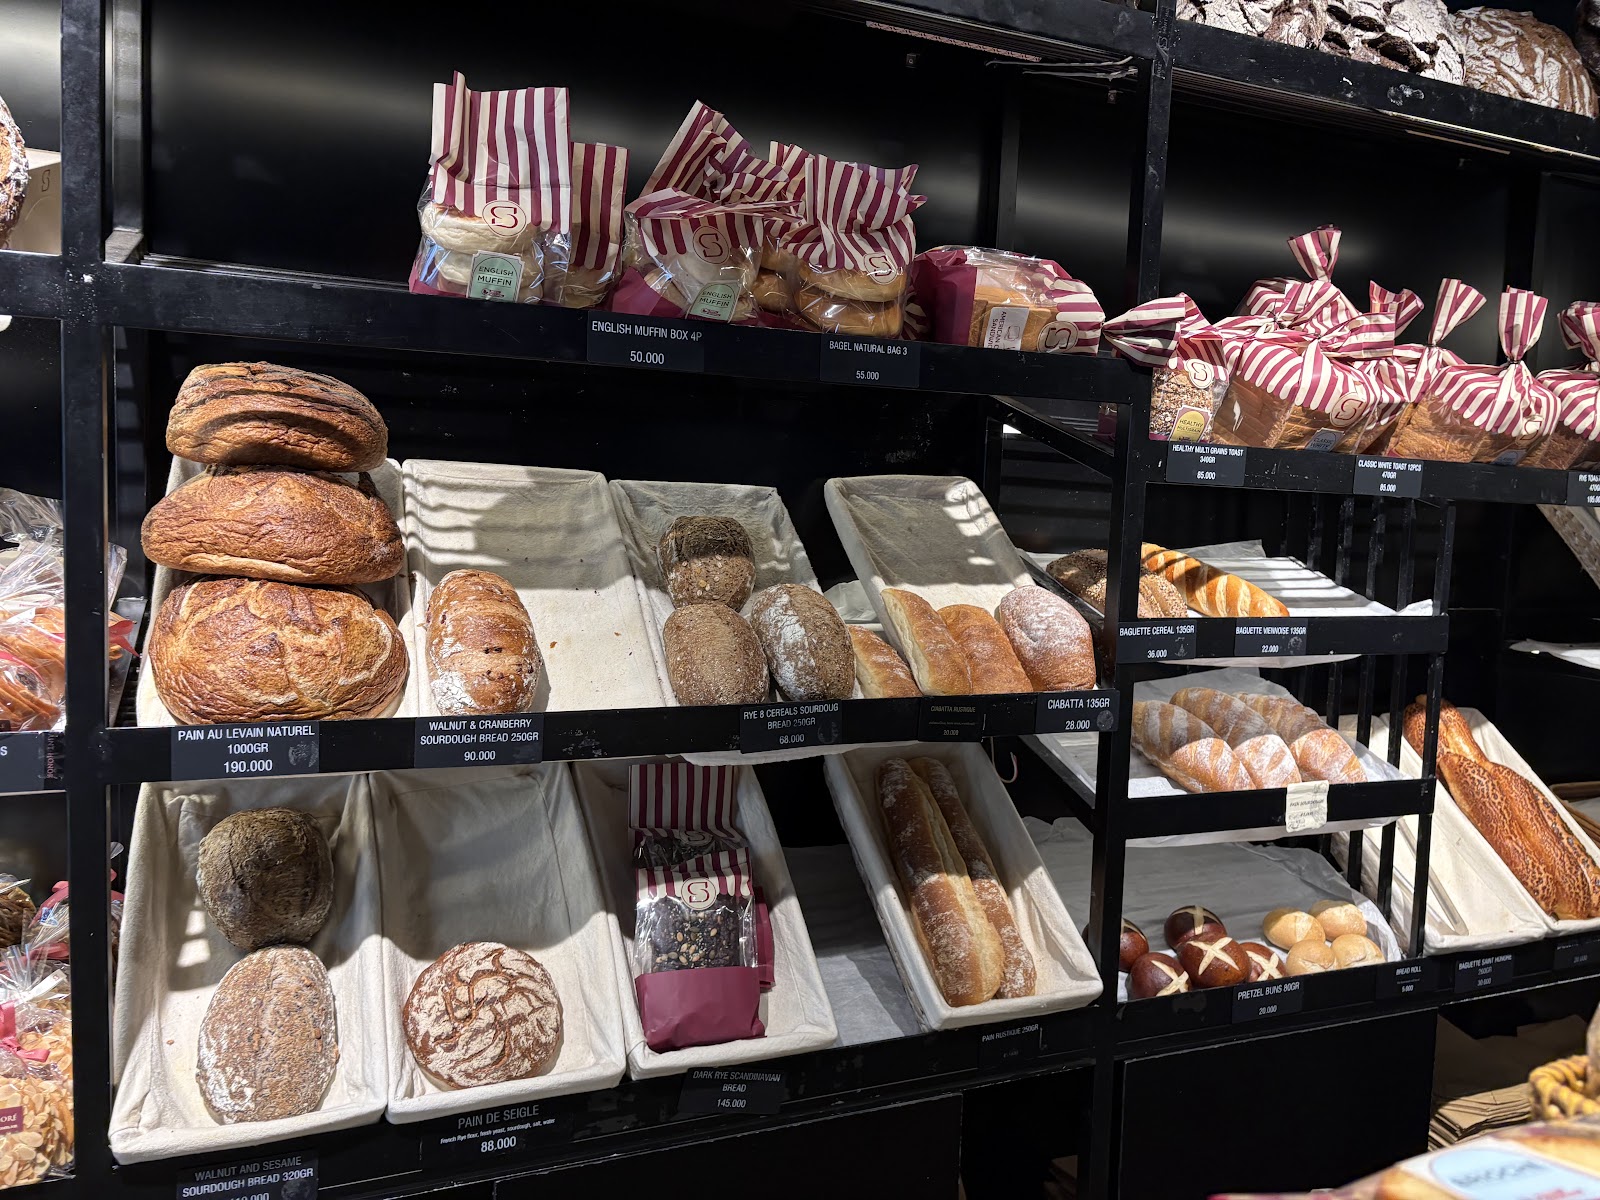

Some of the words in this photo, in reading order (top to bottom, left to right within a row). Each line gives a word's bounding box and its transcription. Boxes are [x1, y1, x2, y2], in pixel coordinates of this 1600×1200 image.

[491, 206, 518, 229] S
[701, 233, 720, 258] S
[478, 265, 514, 277] ENGLISH
[477, 275, 512, 287] MUFFIN
[699, 297, 730, 307] MUFFIN
[702, 291, 733, 300] ENGLISH
[592, 320, 632, 336] ENGLISH
[634, 323, 668, 339] MUFFIN
[670, 327, 689, 341] BOX
[690, 330, 702, 342] 4P
[995, 311, 1007, 343] AMERICAN
[829, 340, 852, 351] BAGEL
[854, 341, 886, 354] NATURAL
[887, 343, 902, 356] BAG
[902, 345, 908, 356] 3
[630, 350, 665, 365] 50.000
[856, 370, 880, 381] 55.000
[1179, 418, 1204, 428] HEALTHY
[1172, 444, 1194, 454] HEALTHY
[1195, 446, 1210, 455] MULTI
[1210, 447, 1228, 456] GRAINS
[1228, 448, 1243, 457] TOAST
[1358, 459, 1377, 468] CLASSIC
[1378, 461, 1392, 470] WHITE
[1392, 462, 1407, 471] TOAST
[1407, 463, 1422, 472] 12PCS
[1196, 470, 1216, 480] 85.000
[1379, 483, 1397, 492] 85.000
[1119, 626, 1151, 637] BAGUETTE
[1152, 625, 1175, 635] CEREAL
[1175, 624, 1195, 635] 135GR
[1235, 626, 1262, 635] BAGUETTE
[1263, 626, 1289, 635] VIENNOISE
[1290, 626, 1307, 635] 135GR
[1147, 649, 1167, 659] 36.000
[1261, 644, 1279, 653] 22.000
[1047, 698, 1084, 710] CIABATTA
[1086, 697, 1111, 709] 135GR
[743, 710, 758, 720] RYE
[759, 709, 765, 719] 8
[766, 706, 798, 718] CEREALS
[800, 702, 839, 715] SOURDOUG
[429, 720, 467, 731] WALNUT
[470, 720, 476, 730] &
[478, 718, 532, 730] CRANBERRY
[767, 719, 792, 730] BREAD
[793, 717, 816, 728] 250GR
[1065, 719, 1090, 731] 28.000
[178, 730, 205, 741] PAIN
[207, 729, 223, 740] AU
[226, 727, 264, 739] LEVAIN
[266, 725, 315, 738] NATUREL
[420, 734, 477, 745] SOURDOUGH
[479, 732, 509, 743] BREAD
[510, 731, 539, 742] 250GR
[779, 733, 805, 745] 68.000
[227, 743, 269, 755] 1000GR
[464, 750, 496, 762] 90.000
[224, 759, 273, 774] 190.000
[687, 881, 710, 904] S
[1410, 965, 1422, 973] ROLL
[1458, 958, 1481, 971] BAGUETTE
[1481, 956, 1494, 967] SAINT
[1237, 985, 1264, 1001] PRETZEL
[1265, 984, 1283, 996] BUNS
[1283, 981, 1300, 993] 80GR
[1258, 1004, 1278, 1016] 20.000
[981, 1033, 995, 1043] PAIN
[995, 1027, 1021, 1040] RUSTIQUE
[692, 1070, 714, 1080] DARK
[714, 1071, 729, 1080] RYE
[729, 1071, 781, 1082] SCANDINAVIAN
[722, 1083, 747, 1093] BREAD
[717, 1098, 747, 1108] 145.000
[0, 1114, 18, 1123] ORÉ
[457, 1115, 483, 1130] PAIN
[485, 1111, 500, 1125] DE
[503, 1104, 540, 1122] SEIGLE
[440, 1136, 457, 1145] French
[480, 1136, 517, 1153] 88.000
[194, 1166, 237, 1182] WALNUT
[239, 1163, 260, 1174] AND
[262, 1155, 302, 1171] SESAME
[182, 1179, 245, 1198] SOURDOUGH
[247, 1173, 280, 1187] BREAD
[282, 1167, 314, 1182] 320GR
